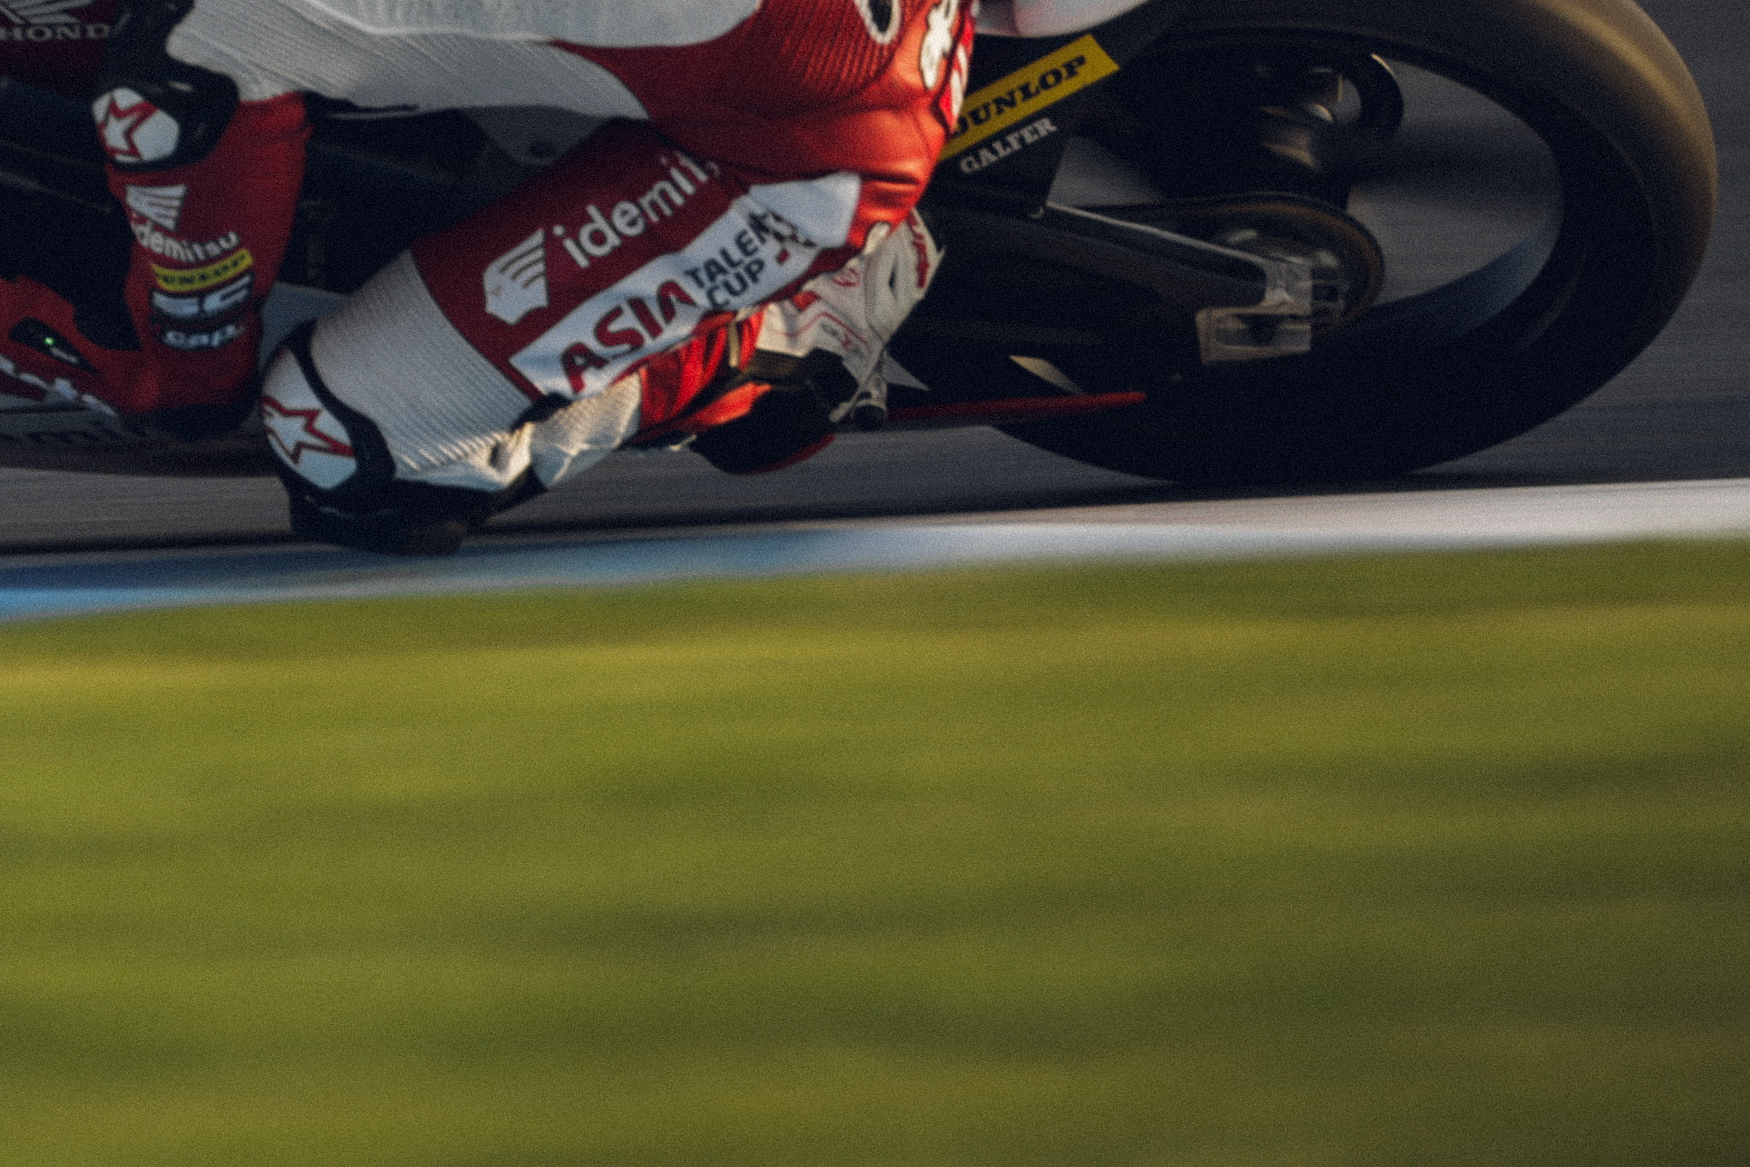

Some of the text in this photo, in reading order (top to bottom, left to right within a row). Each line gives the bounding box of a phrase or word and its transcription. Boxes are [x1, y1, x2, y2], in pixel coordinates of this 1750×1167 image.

[959, 117, 1058, 175] GALFER
[706, 255, 766, 311] CUP
[560, 280, 698, 394] ASIA
